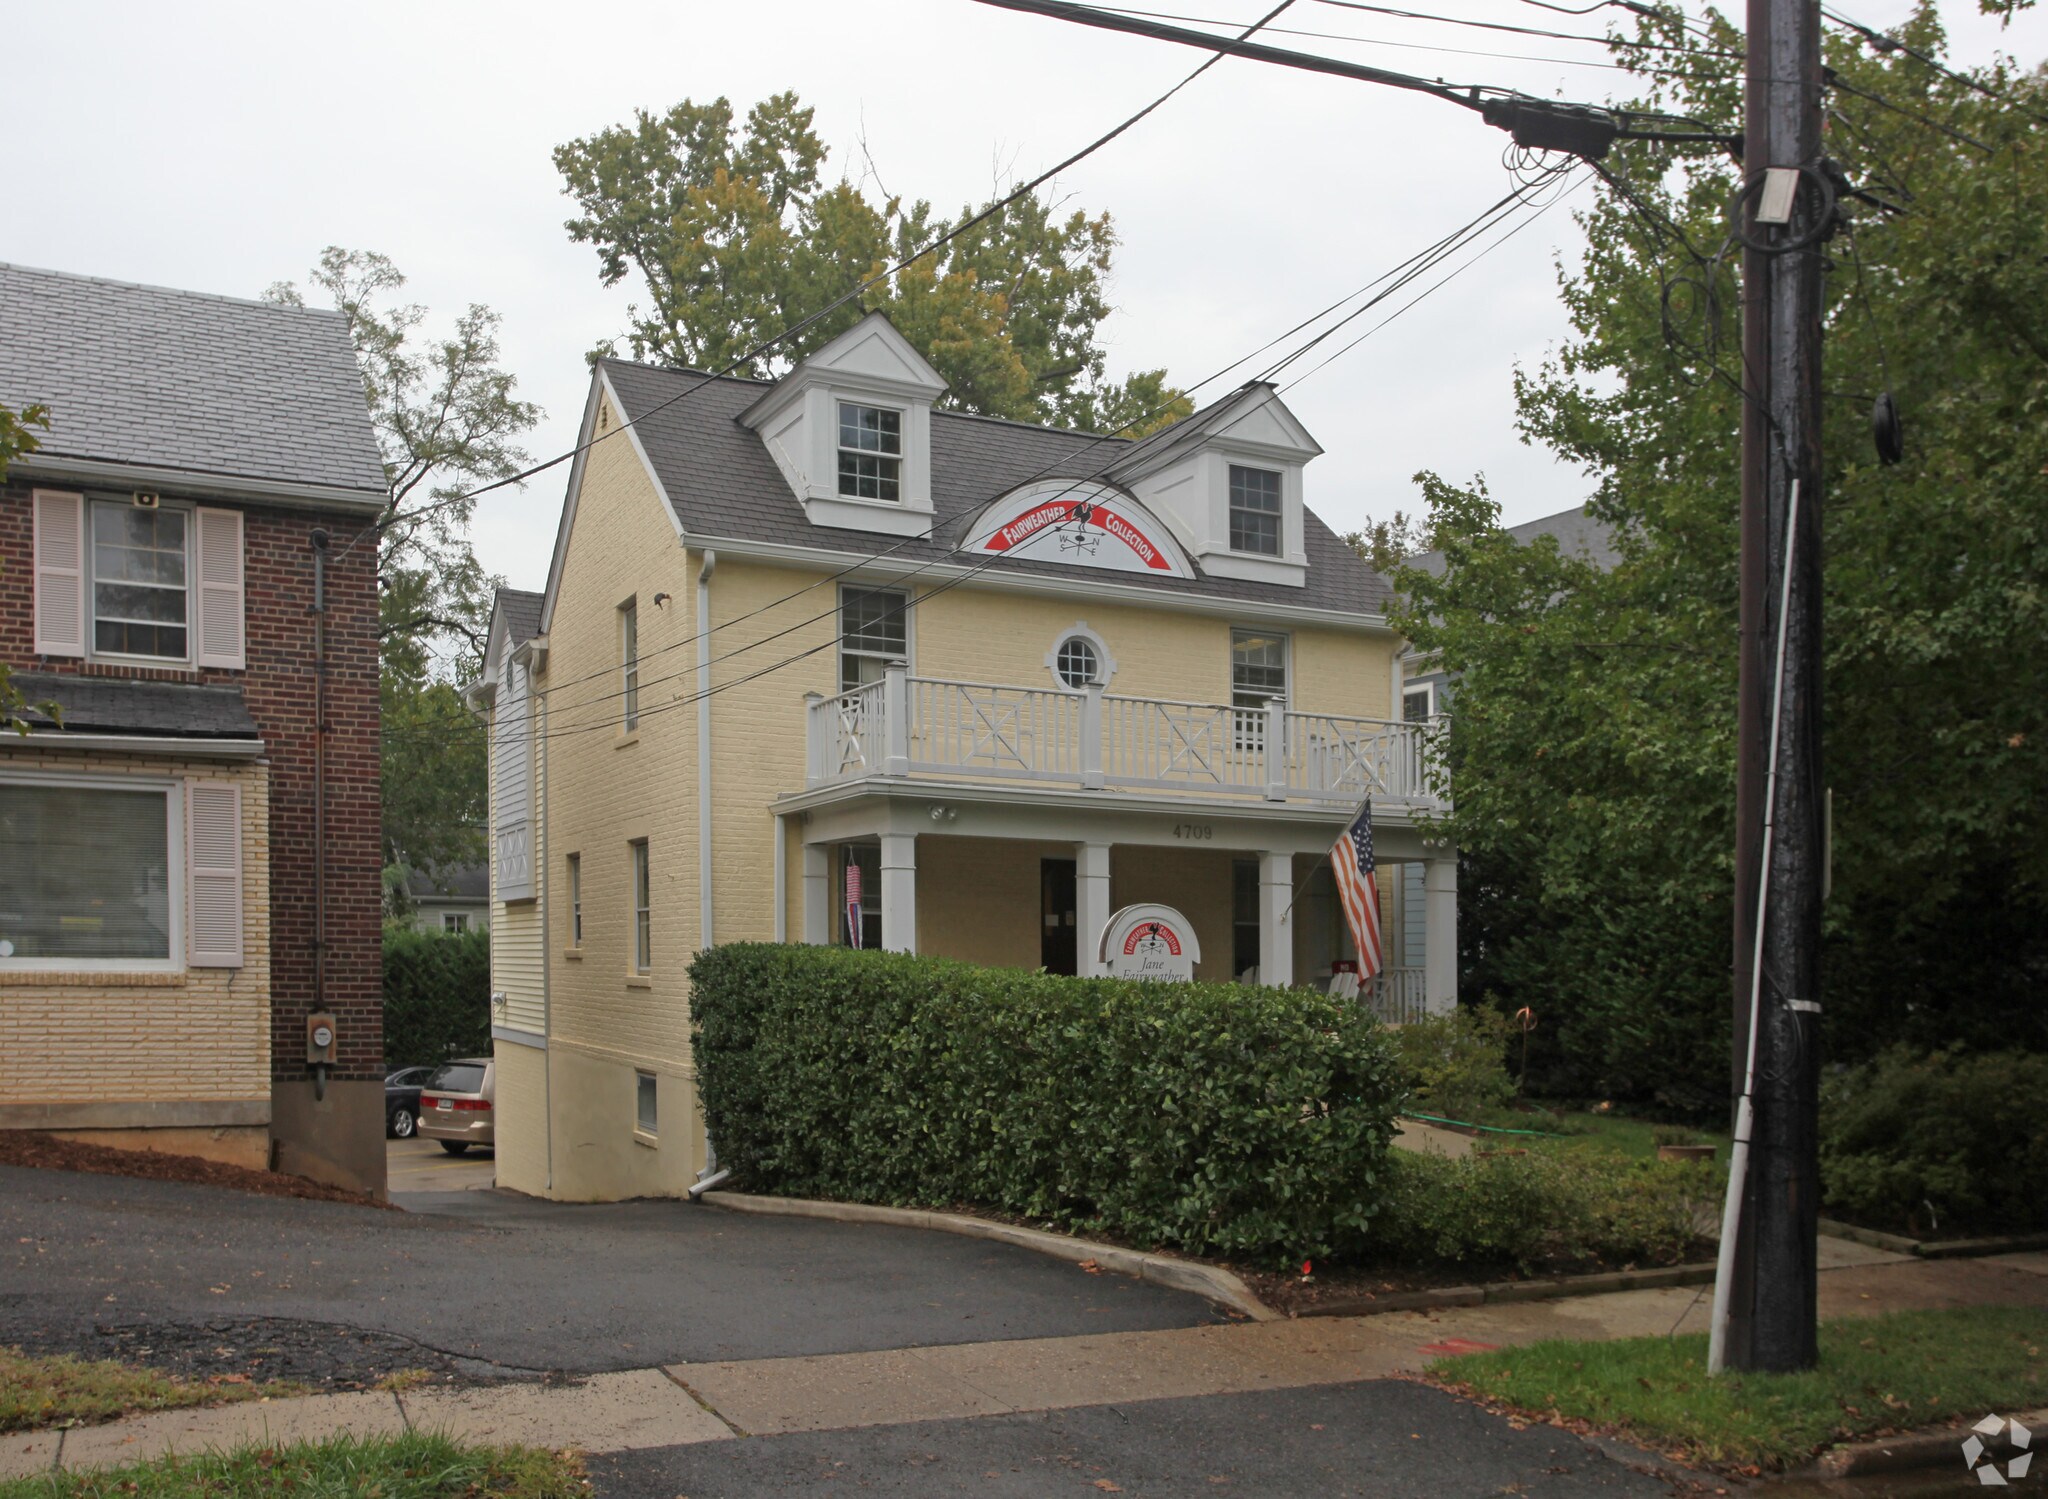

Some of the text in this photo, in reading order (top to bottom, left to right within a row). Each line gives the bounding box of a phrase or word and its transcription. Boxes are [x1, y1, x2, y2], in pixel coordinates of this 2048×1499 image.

[1002, 506, 1154, 562] FAIRWEATHER COLLECTION
[1059, 534, 1100, 546] W N
[1173, 824, 1212, 840] 4709
[1140, 957, 1164, 972] Jane
